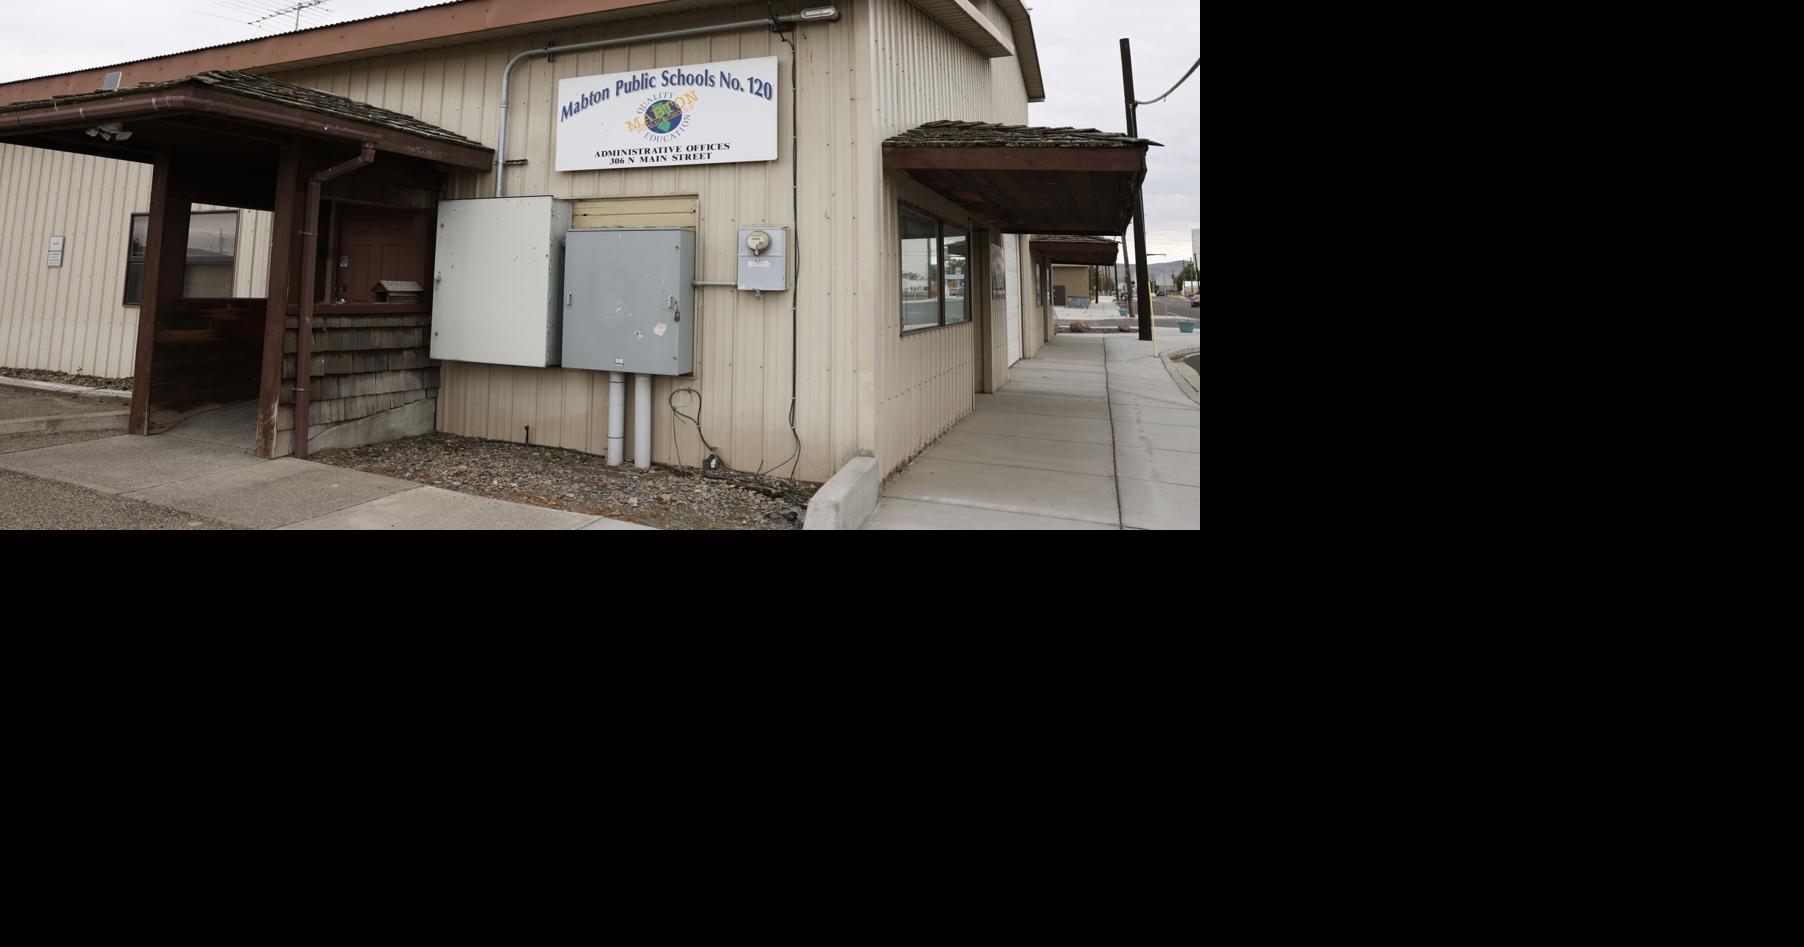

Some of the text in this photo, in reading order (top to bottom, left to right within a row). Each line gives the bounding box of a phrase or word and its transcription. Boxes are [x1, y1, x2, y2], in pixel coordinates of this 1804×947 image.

[560, 87, 610, 122] Mabton
[615, 72, 656, 96] Public
[661, 68, 715, 87] Schools
[719, 71, 744, 92] No.
[747, 76, 773, 101] 120
[637, 91, 673, 114] QUALITY
[625, 90, 698, 131] MABTON
[643, 113, 690, 142] EDUCATION
[594, 142, 731, 158] ADMINISTRATIVE OFFICES
[609, 157, 625, 165] 306
[640, 155, 668, 163] MAIN
[672, 152, 713, 161] STREET
